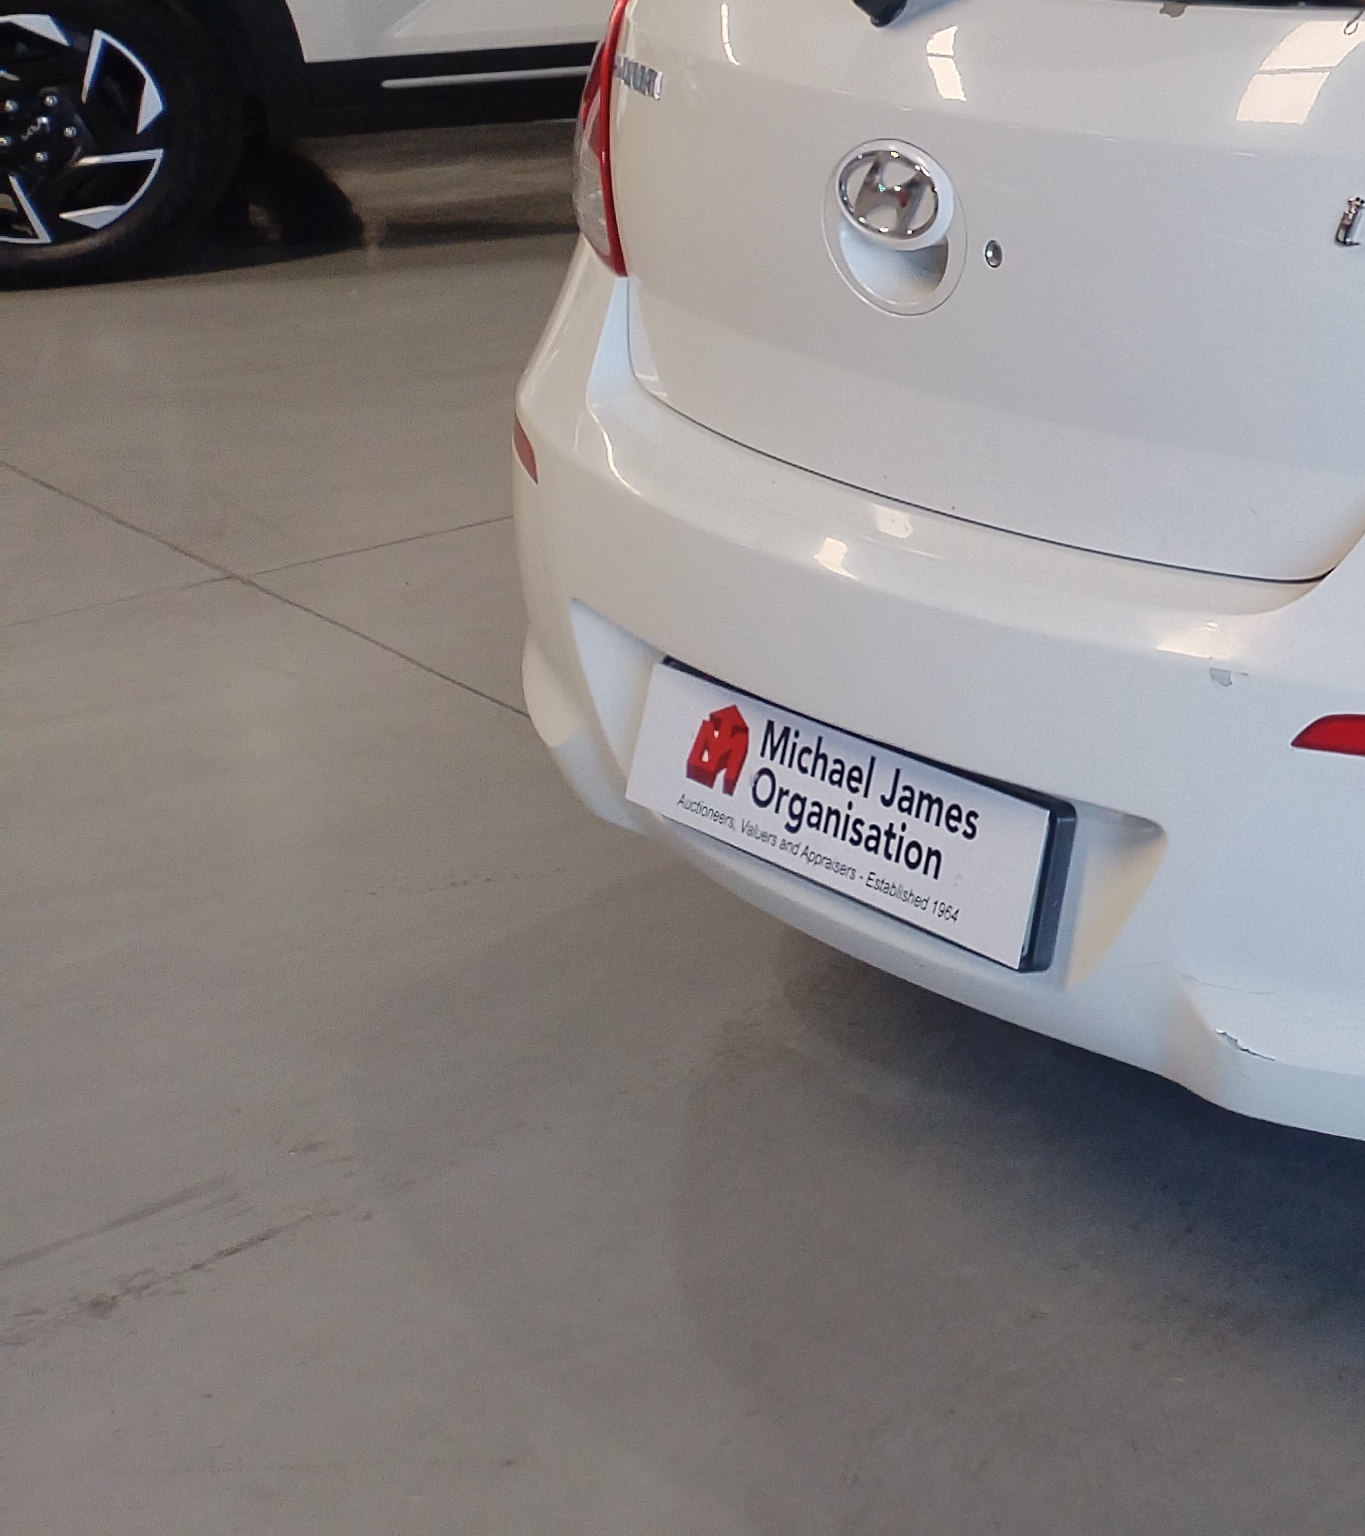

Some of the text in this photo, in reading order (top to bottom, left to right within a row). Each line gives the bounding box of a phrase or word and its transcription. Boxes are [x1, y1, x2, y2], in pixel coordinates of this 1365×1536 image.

[751, 767, 942, 880] Organisation
[759, 719, 980, 840] Michael James
[677, 793, 736, 829] Auctioneers,
[740, 818, 778, 848] Valuers
[779, 836, 802, 856] and
[800, 846, 857, 881] Appraisers
[865, 871, 930, 911] Established
[932, 900, 960, 923] 1964
